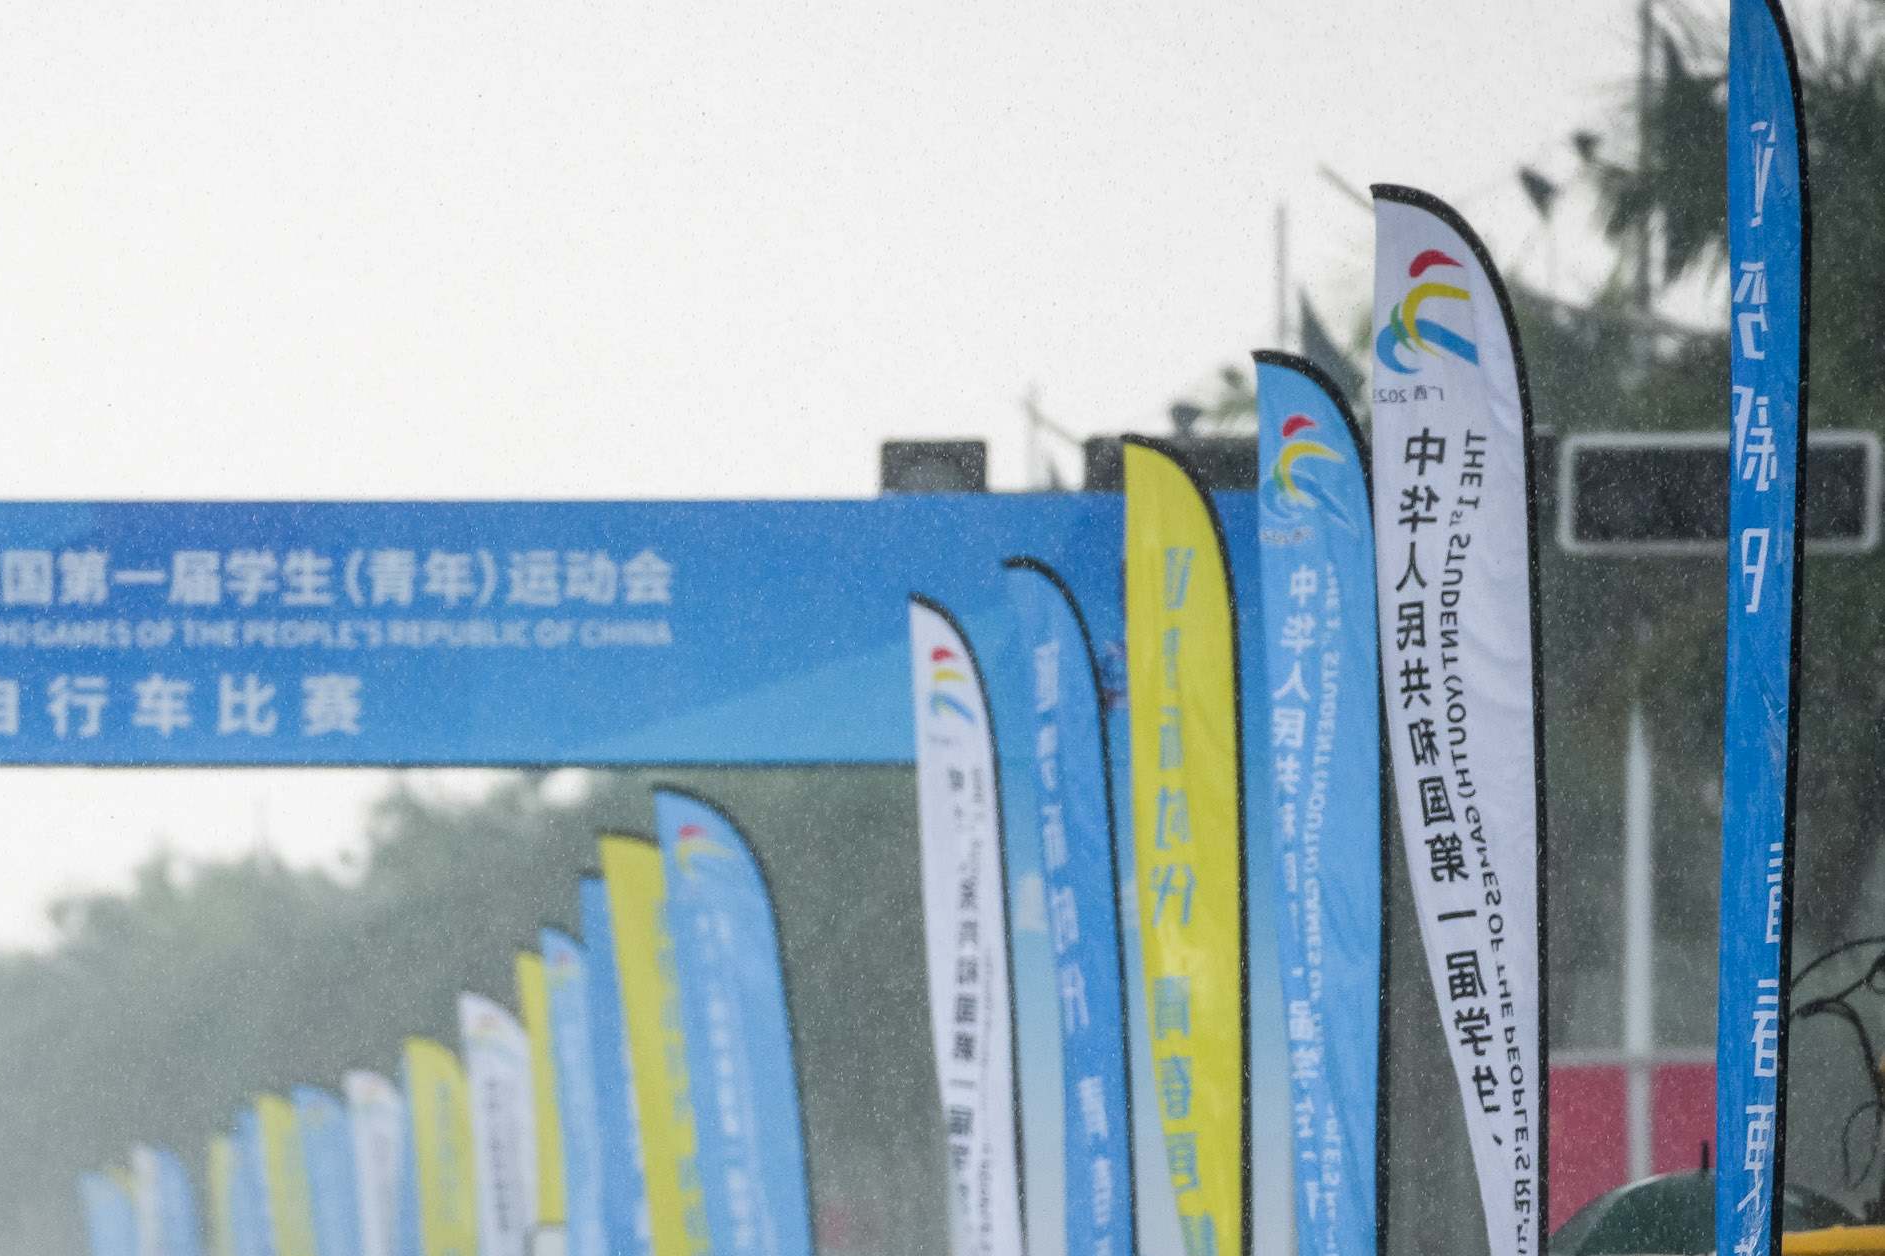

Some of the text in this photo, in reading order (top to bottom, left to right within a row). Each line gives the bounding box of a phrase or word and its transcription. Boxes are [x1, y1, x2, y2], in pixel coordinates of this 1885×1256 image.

[34, 619, 131, 647] GAMES
[135, 619, 173, 647] OF
[182, 619, 237, 647] THE
[534, 619, 572, 647] OF
[579, 619, 674, 647] CHINA
